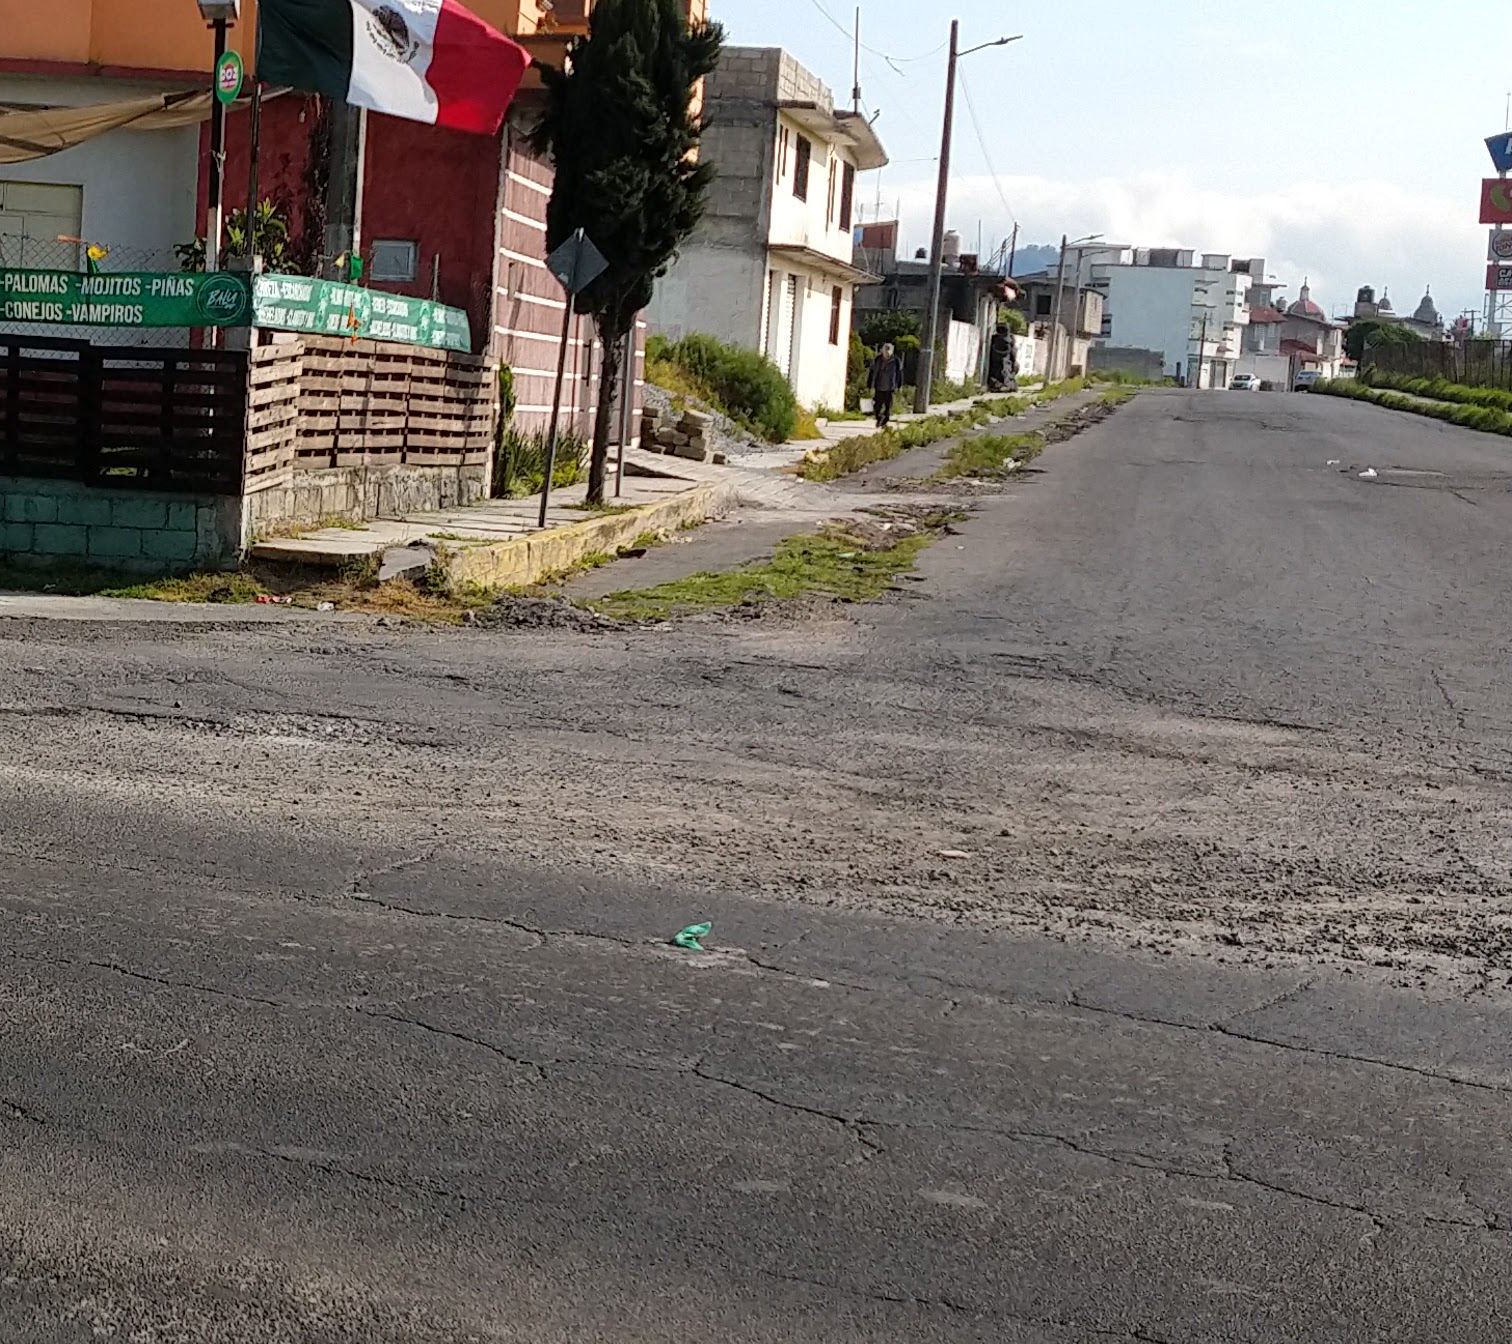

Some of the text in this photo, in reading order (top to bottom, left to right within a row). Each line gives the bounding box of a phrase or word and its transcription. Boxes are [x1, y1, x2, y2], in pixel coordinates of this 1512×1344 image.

[0, 274, 195, 298] -PALOMAS -MOJITOS -PIÑAS
[0, 301, 143, 324] -CONEJOS -VAMPIROS
